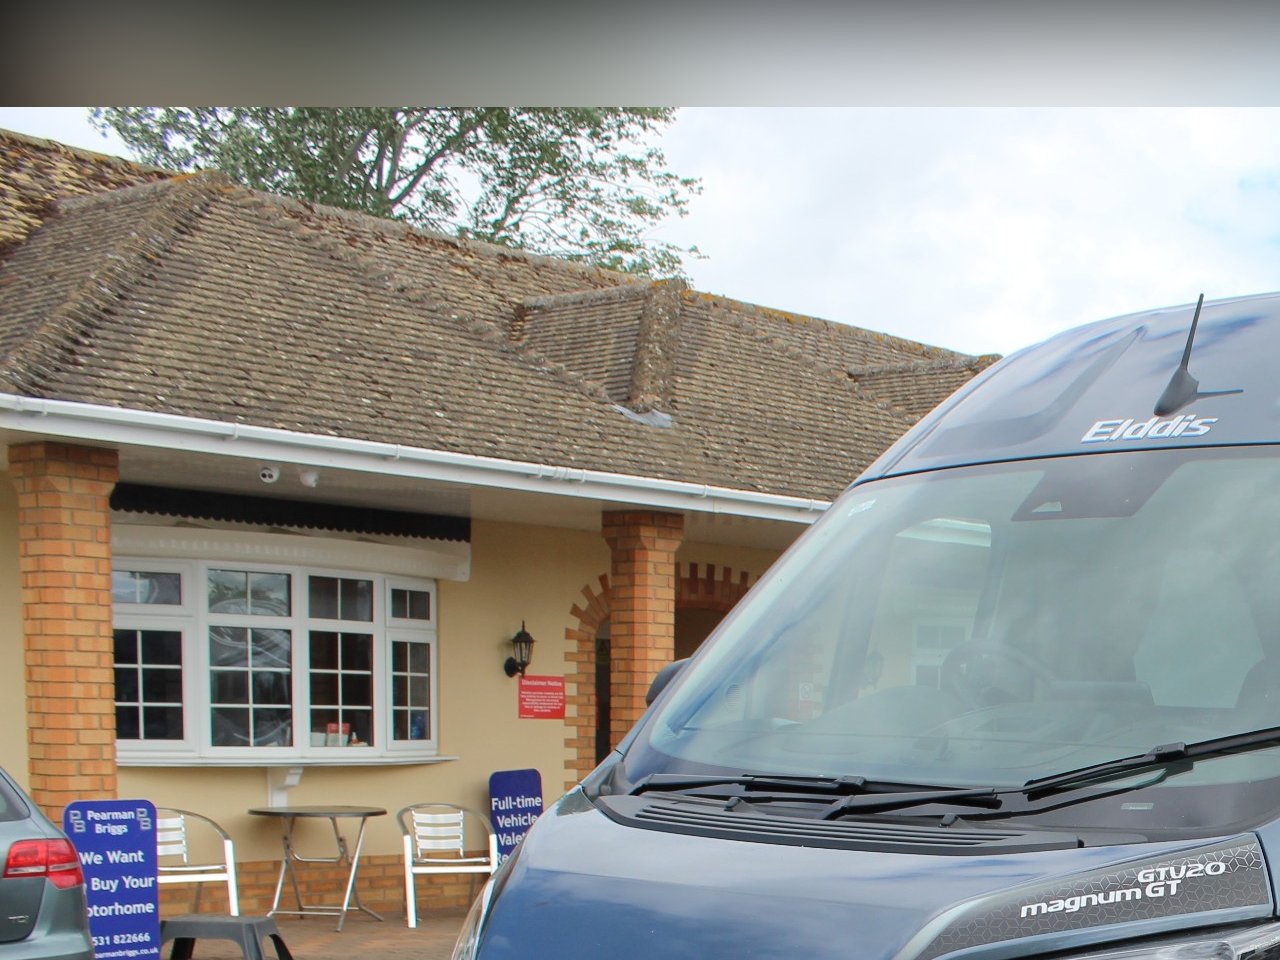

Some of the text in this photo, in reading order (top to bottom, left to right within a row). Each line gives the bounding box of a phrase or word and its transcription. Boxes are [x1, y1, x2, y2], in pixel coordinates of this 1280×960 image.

[1080, 414, 1219, 444] Elddis
[491, 795, 542, 811] Full-time
[87, 810, 135, 821] Pearman
[496, 812, 538, 829] Vehicle
[95, 823, 128, 835] Briggs
[79, 850, 145, 865] We Want
[1137, 861, 1226, 883] GTV20
[91, 877, 119, 893] Buy
[121, 875, 155, 889] Your
[1020, 879, 1182, 918] magnum GT
[88, 902, 155, 918] otorhome
[92, 932, 151, 947] 531 822666
